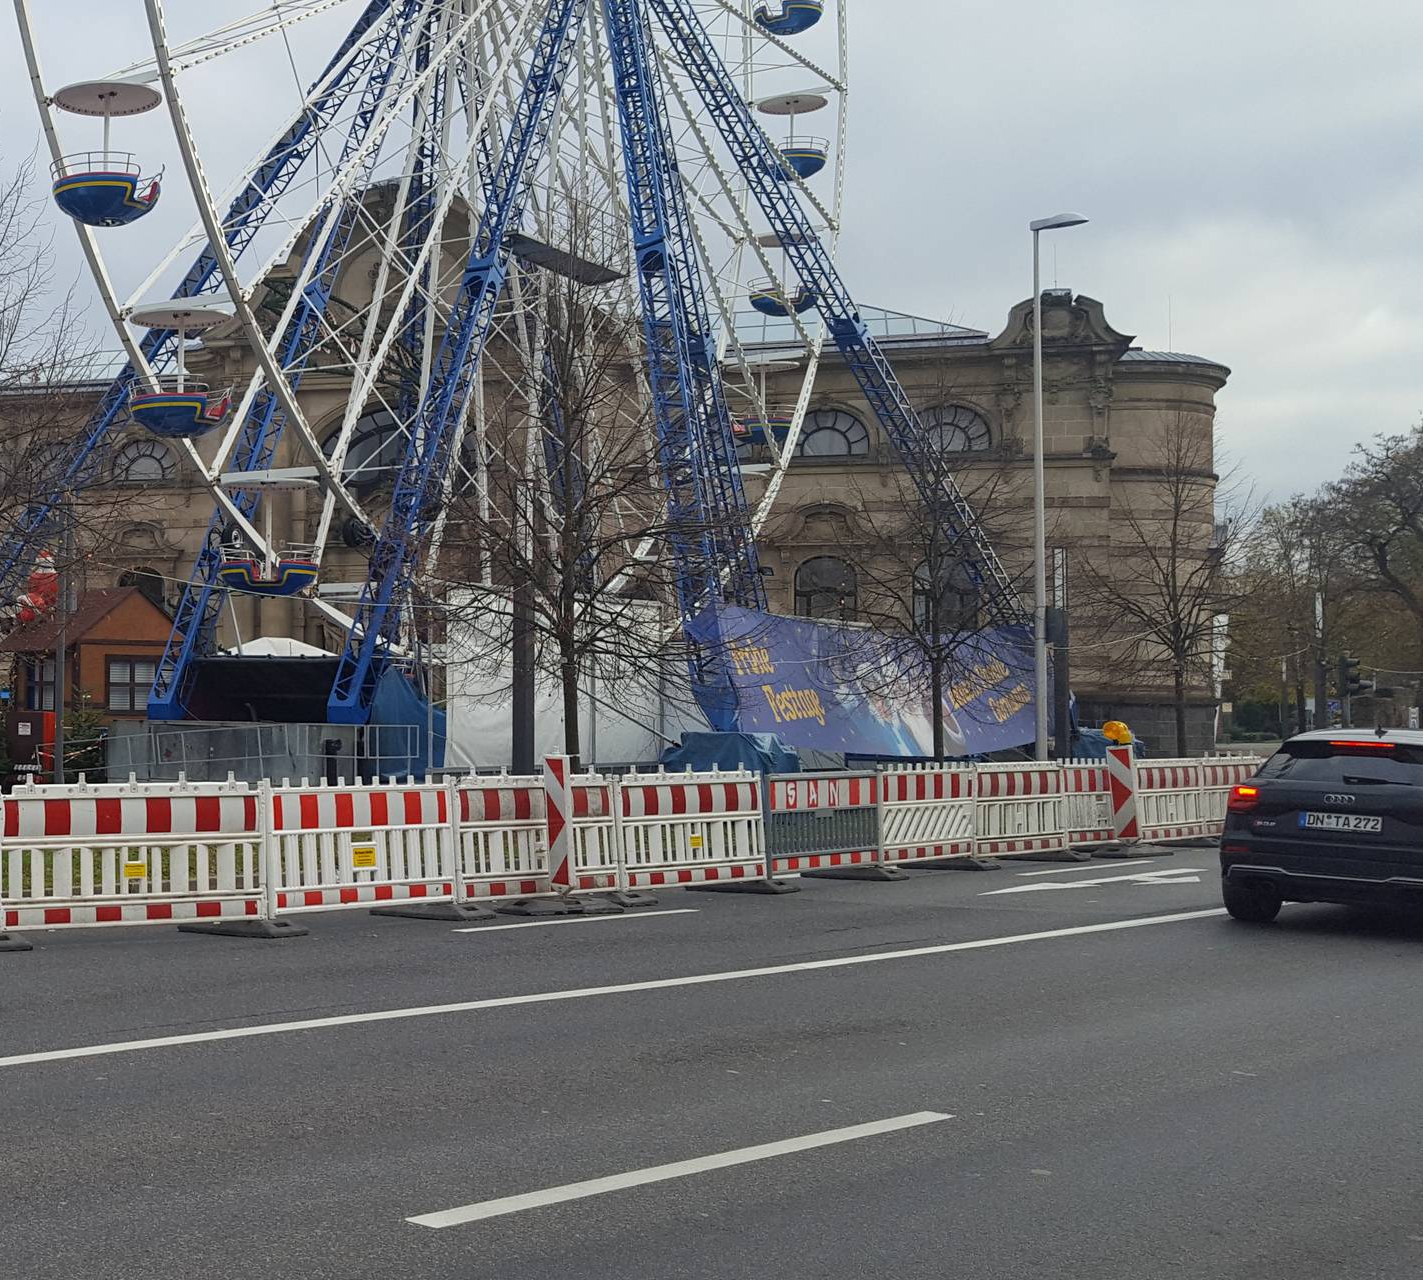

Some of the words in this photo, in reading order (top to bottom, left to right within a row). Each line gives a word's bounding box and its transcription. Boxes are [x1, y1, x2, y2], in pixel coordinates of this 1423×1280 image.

[1307, 813, 1325, 826] DN
[1334, 815, 1350, 828] TA
[1353, 816, 1380, 831] 272
